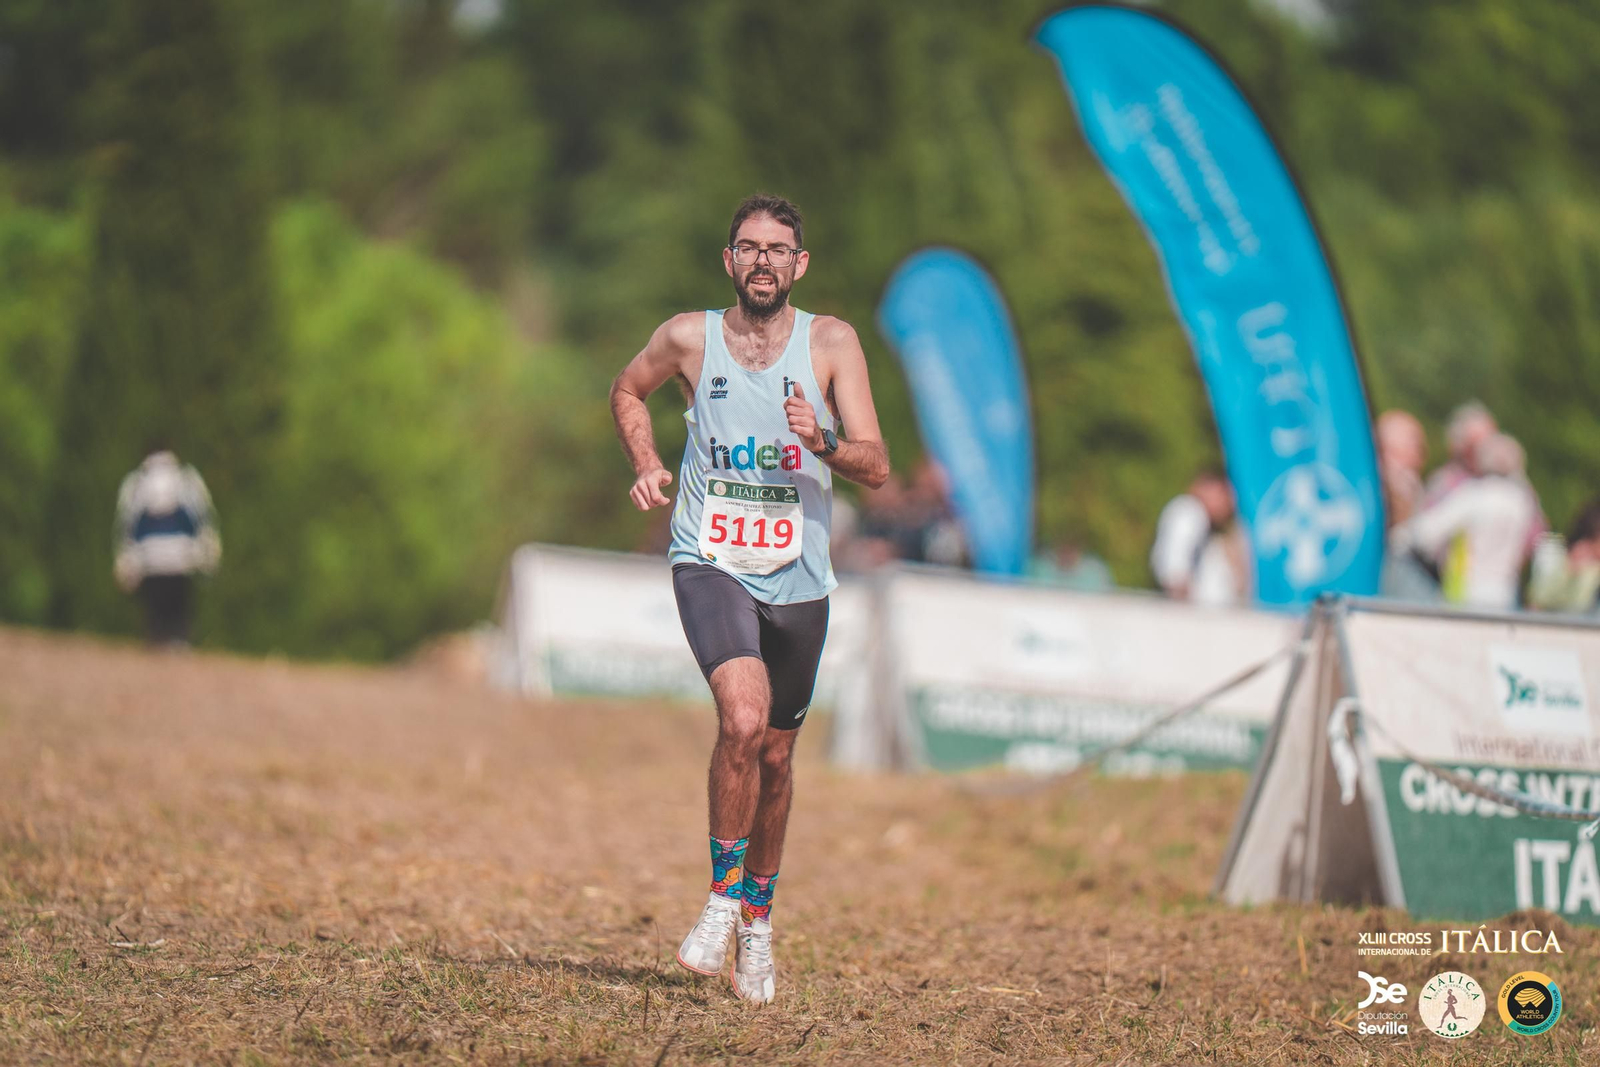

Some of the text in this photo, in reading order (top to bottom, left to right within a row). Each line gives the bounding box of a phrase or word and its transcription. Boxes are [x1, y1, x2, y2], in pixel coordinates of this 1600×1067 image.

[709, 436, 802, 471] indea
[732, 485, 777, 499] ITÁLICA
[708, 513, 794, 549] 5119
[1399, 763, 1520, 818] CROSS
